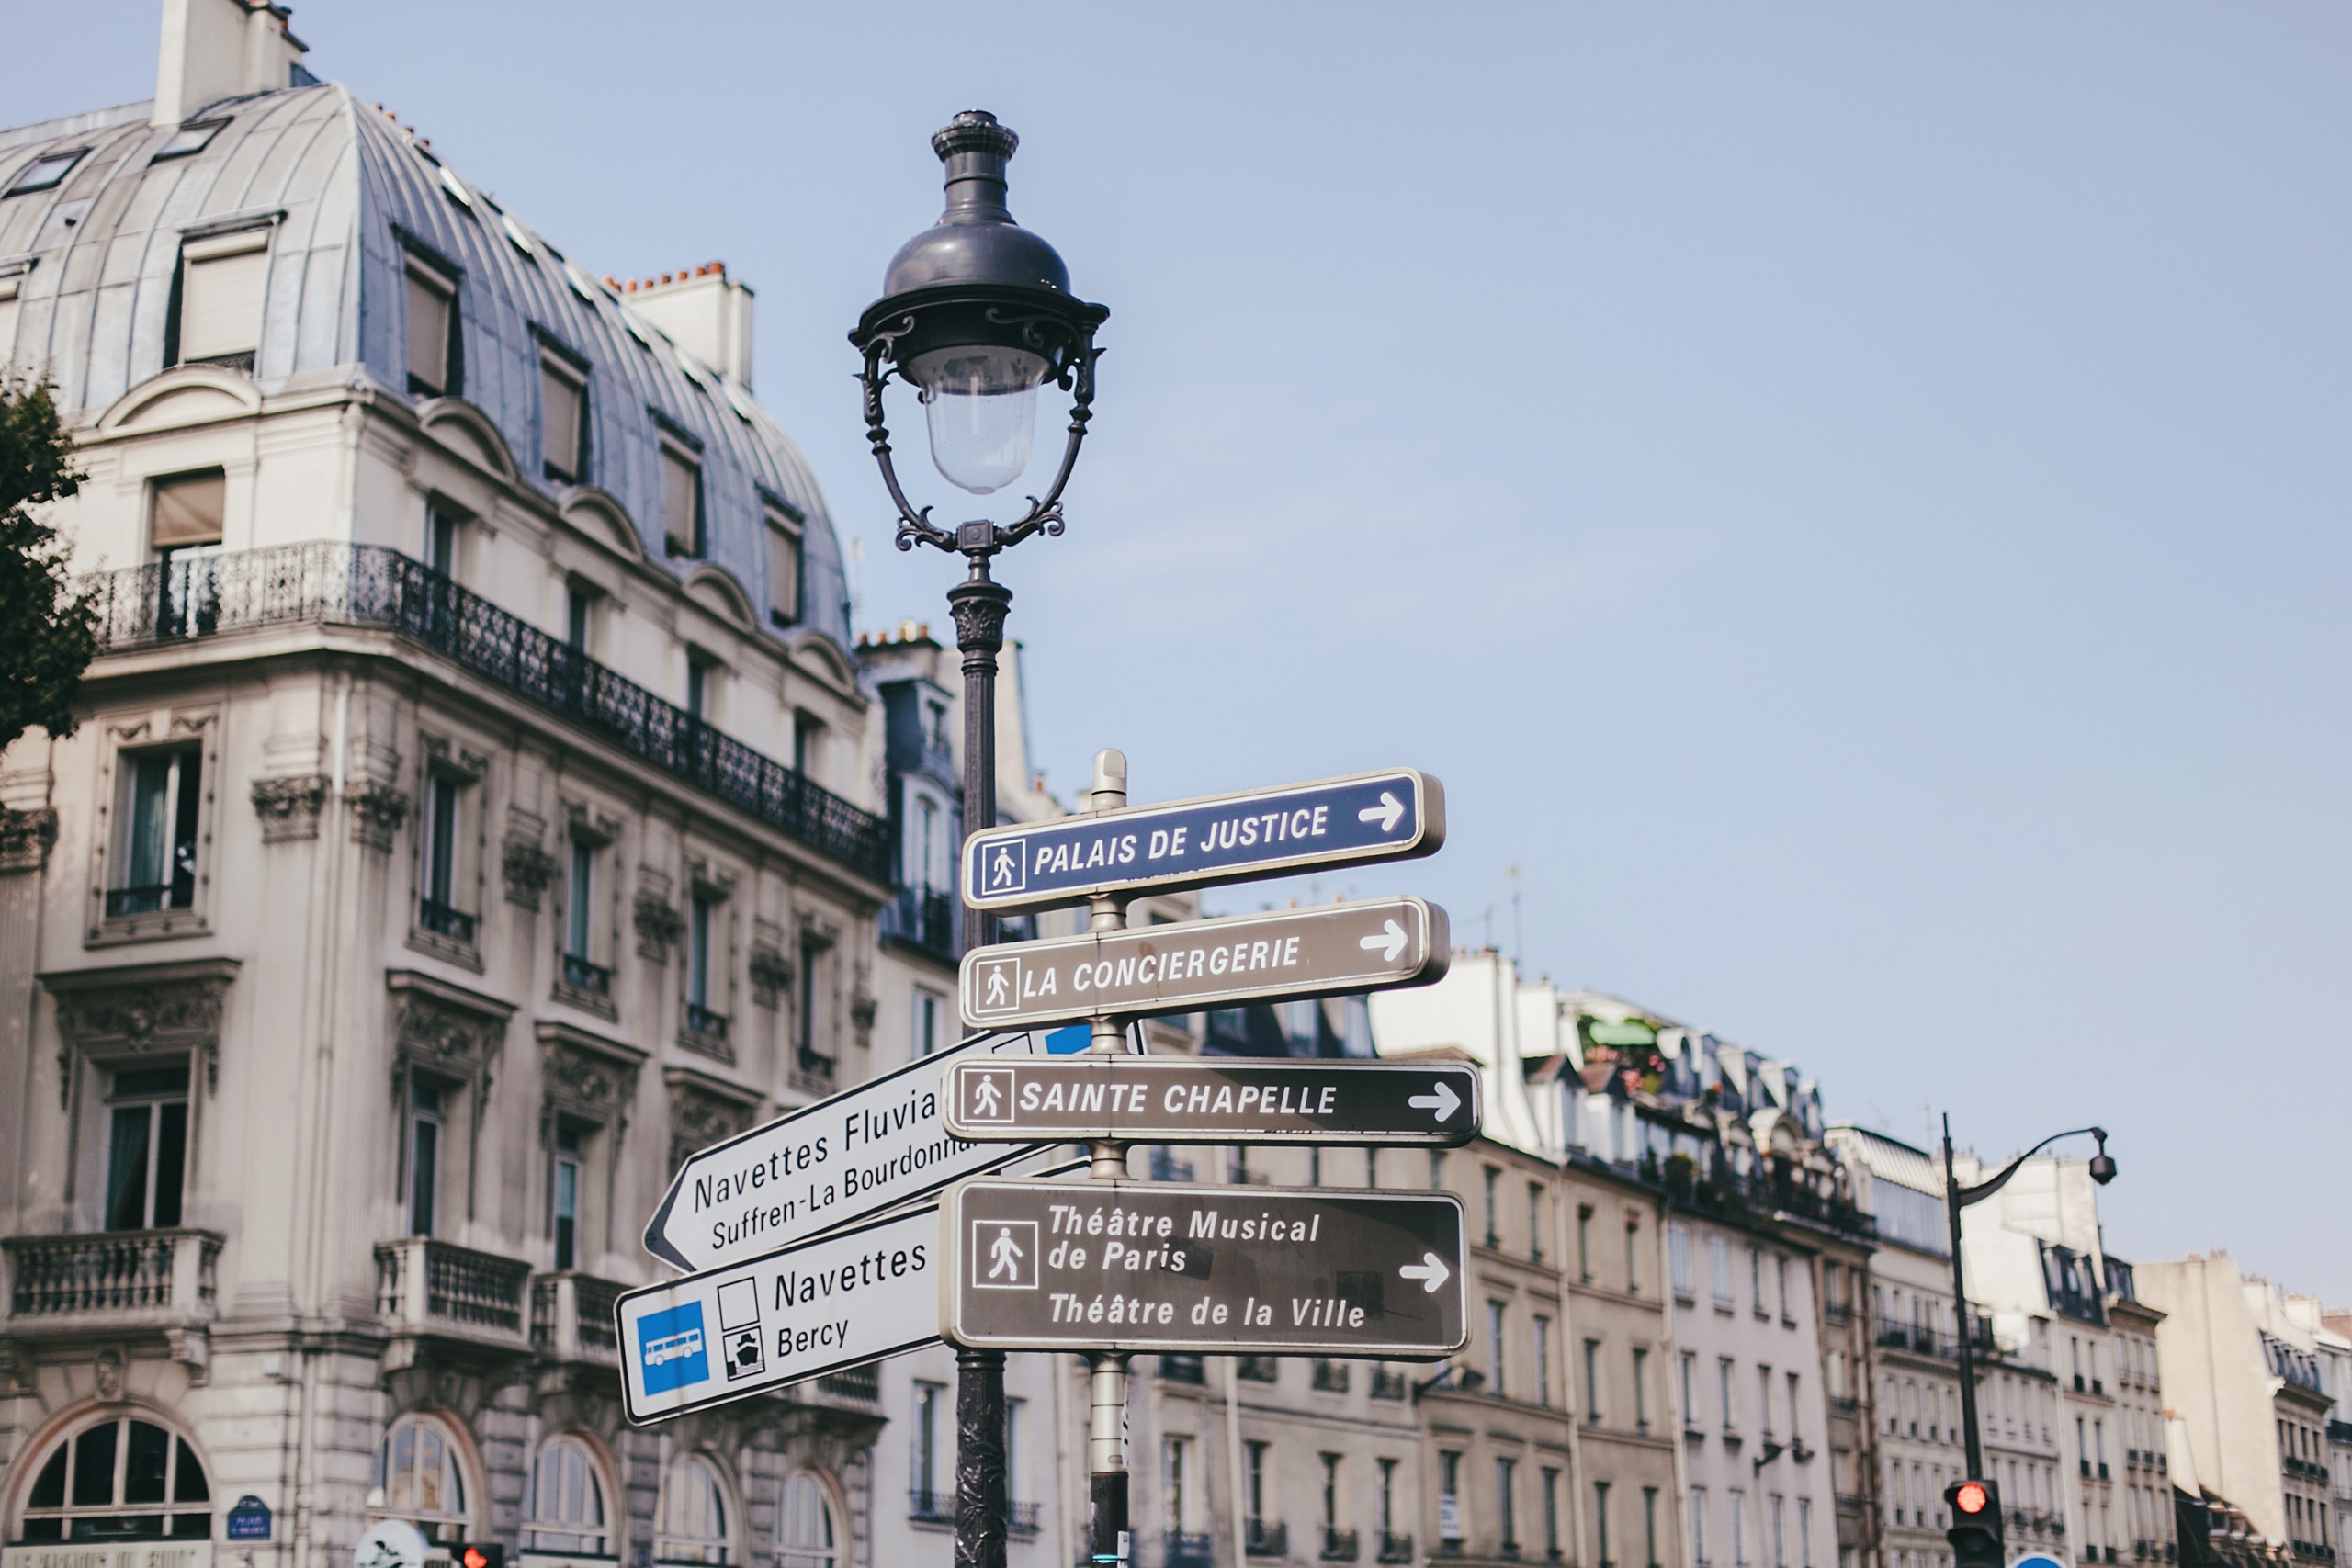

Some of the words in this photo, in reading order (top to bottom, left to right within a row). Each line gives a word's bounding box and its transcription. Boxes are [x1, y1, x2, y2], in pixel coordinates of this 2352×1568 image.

[1035, 835, 1136, 874] PALAIS
[1149, 827, 1187, 859] DE
[1201, 806, 1328, 852] JUSTICE
[1023, 968, 1056, 998] LA
[1074, 937, 1299, 991] CONCIERGERIE
[1020, 1083, 1148, 1111] SAINTE
[1164, 1085, 1336, 1113] CHAPELLE
[695, 1137, 827, 1213] Navettes
[846, 1082, 942, 1151] Fluvia
[1049, 1205, 1172, 1237] Théâtre
[1189, 1211, 1319, 1241] Musical
[1049, 1241, 1086, 1269] de
[1102, 1242, 1185, 1271] Paris
[775, 1245, 925, 1310] Navettes
[1050, 1294, 1173, 1324] Théâtre
[1192, 1297, 1227, 1325] de
[1244, 1298, 1272, 1325] la
[1293, 1299, 1363, 1327] Ville
[778, 1320, 848, 1358] Bercy
